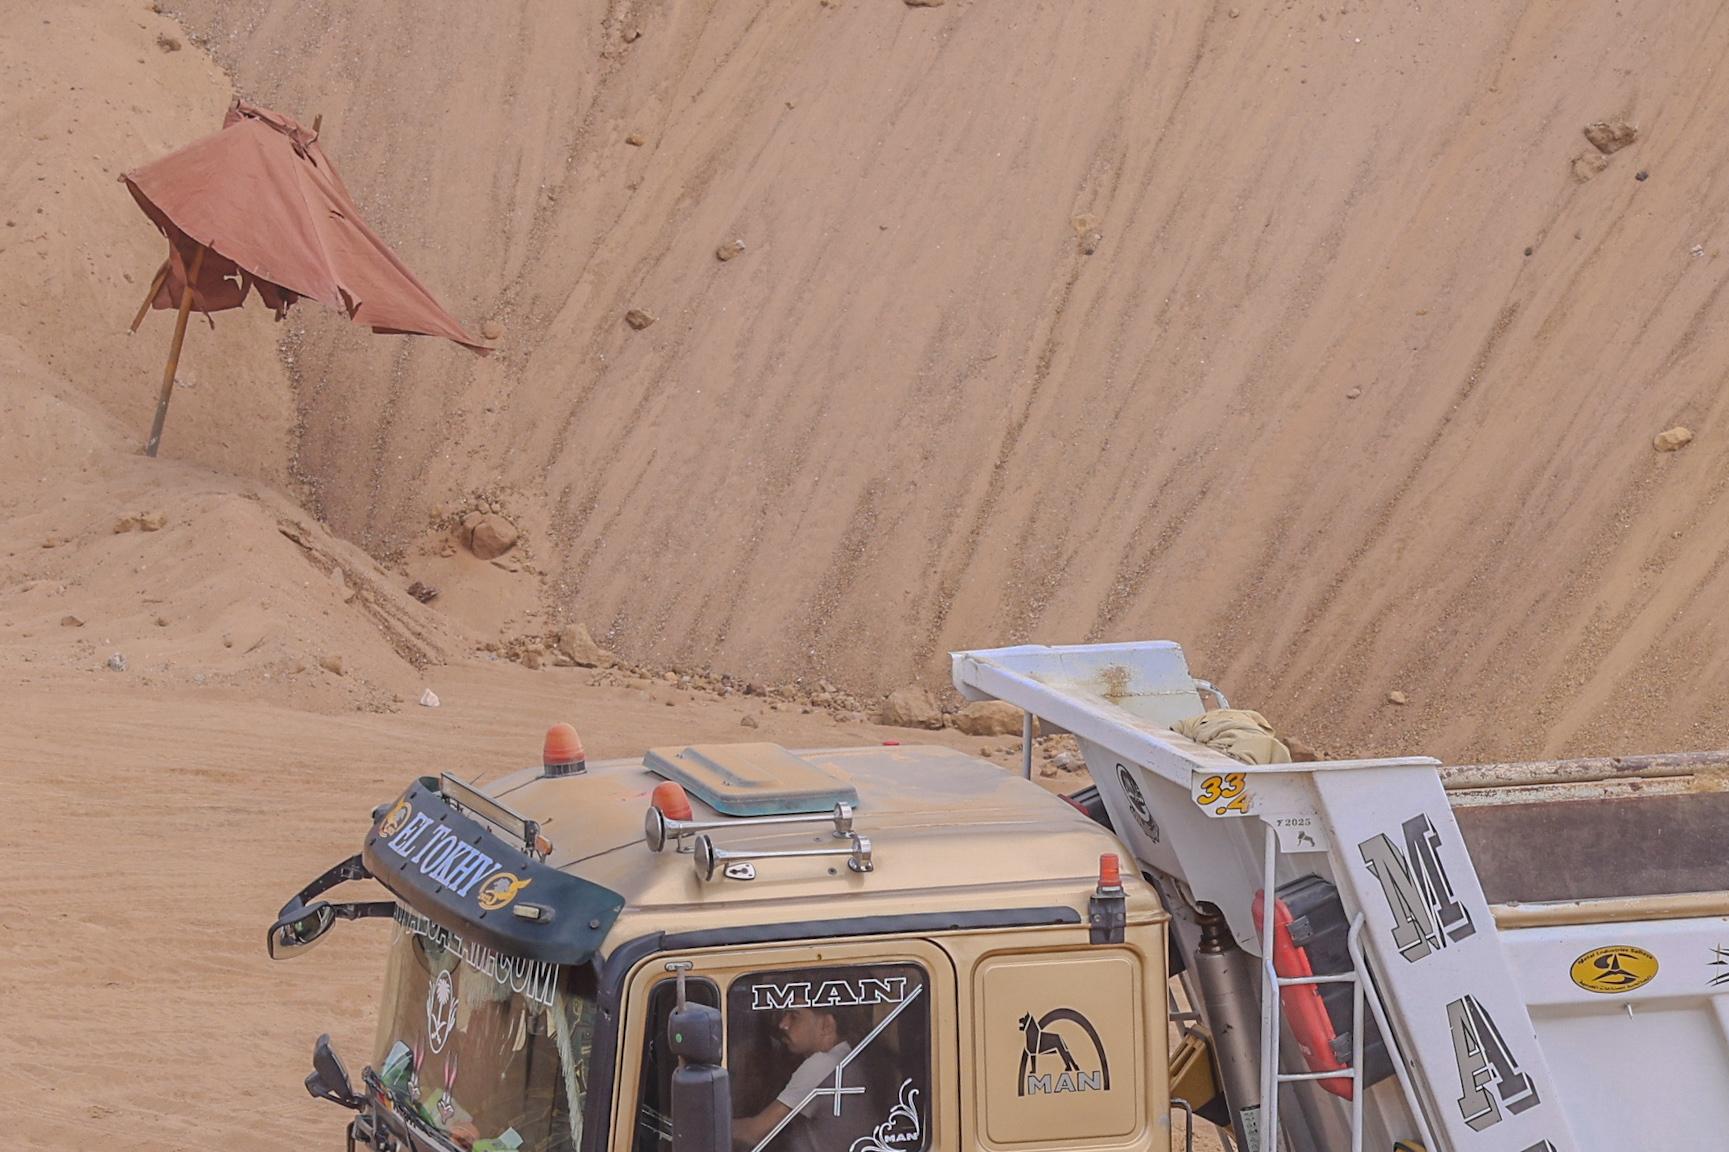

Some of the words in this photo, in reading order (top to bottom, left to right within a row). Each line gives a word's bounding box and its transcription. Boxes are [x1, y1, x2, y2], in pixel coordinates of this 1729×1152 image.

[1285, 818, 1311, 827] 2025
[388, 812, 434, 858] EL
[411, 824, 503, 898] TOKHY
[752, 977, 907, 1010] MAN
[1028, 1071, 1101, 1095] MAN
[884, 1132, 919, 1144] MAN
